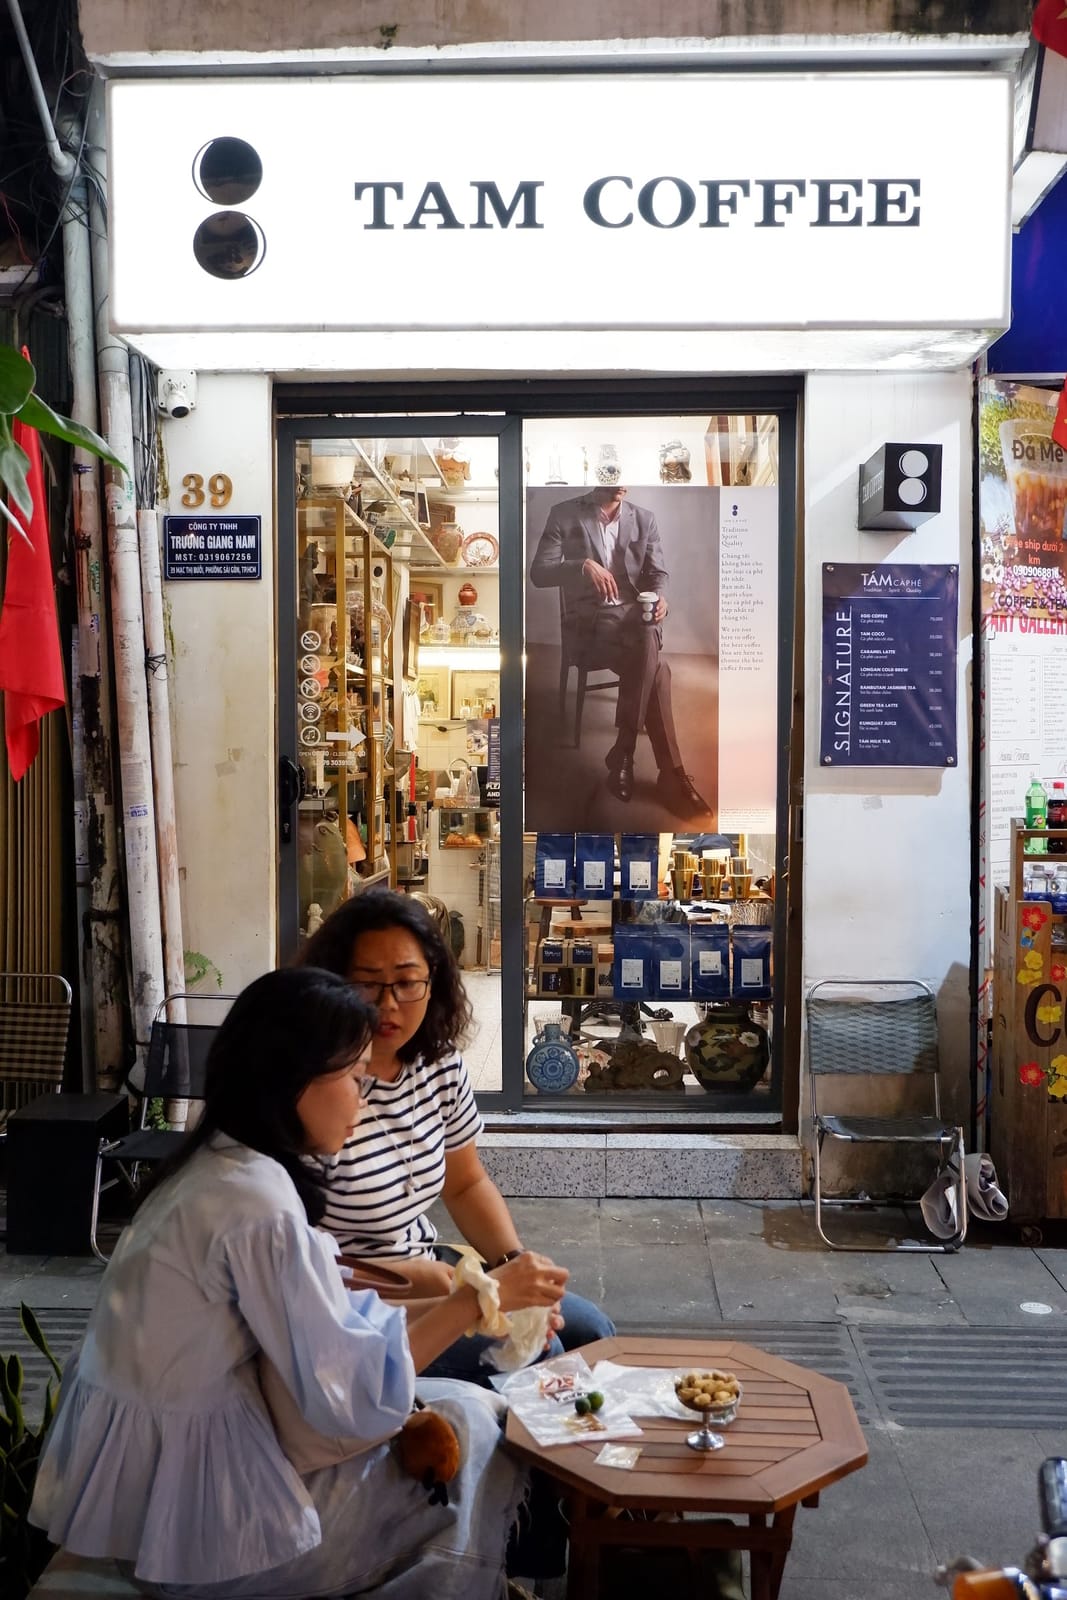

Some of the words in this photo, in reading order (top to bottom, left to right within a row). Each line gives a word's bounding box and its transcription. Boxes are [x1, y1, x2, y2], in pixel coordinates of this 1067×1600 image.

[355, 182, 544, 229] TAM
[584, 177, 921, 229] COFFEE
[181, 473, 233, 508] 39
[188, 522, 207, 530] CÔNG
[207, 535, 233, 549] GIANG
[235, 535, 256, 549] NAM
[1024, 538, 1041, 553] ship
[1059, 543, 1064, 552] 2
[175, 553, 197, 561] MST:
[199, 553, 251, 561] 0319067256
[1028, 554, 1041, 565] km
[860, 570, 893, 586] TÁM
[998, 594, 1038, 609] COFFEE
[1039, 597, 1048, 609] &
[834, 611, 851, 751] SIGNATURE
